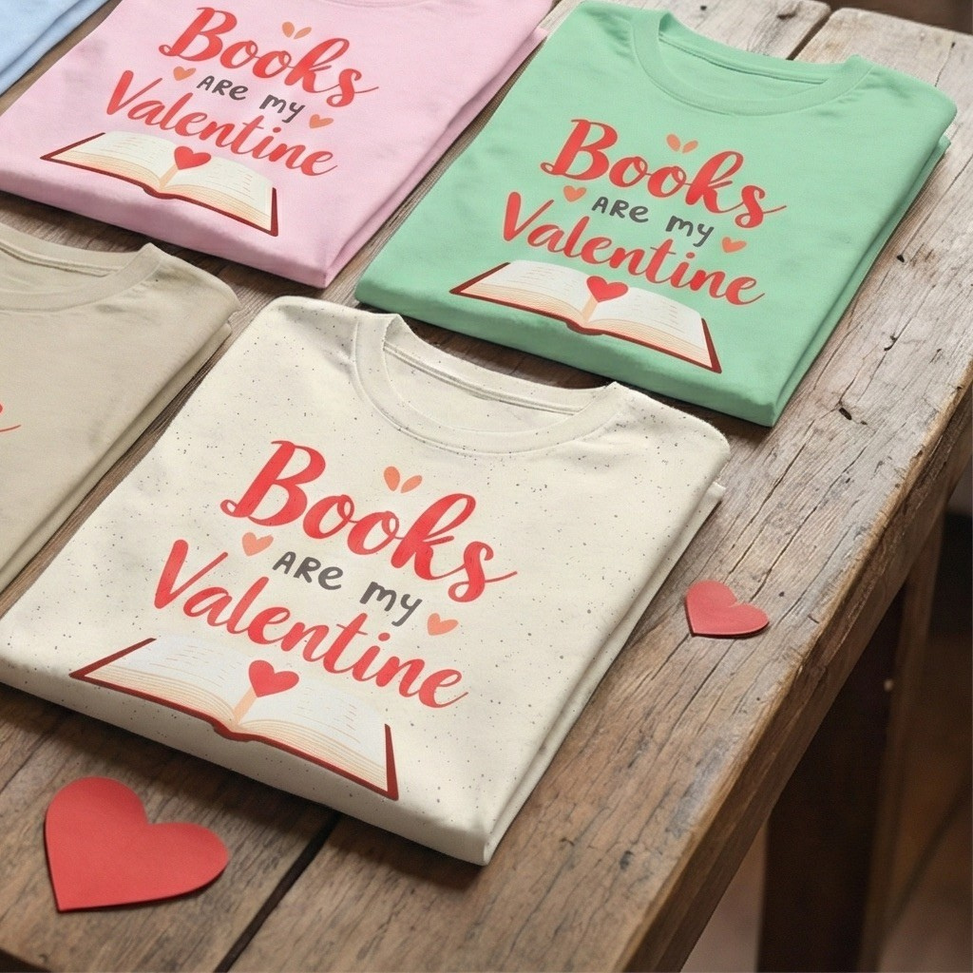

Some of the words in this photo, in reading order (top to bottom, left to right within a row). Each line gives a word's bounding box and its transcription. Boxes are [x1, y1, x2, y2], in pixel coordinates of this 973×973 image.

[158, 7, 379, 107] Books
[259, 93, 305, 123] my
[106, 70, 338, 176] Valentine
[540, 118, 787, 228] Books
[503, 191, 766, 305] Valentine
[665, 215, 715, 247] my
[219, 439, 518, 603] Books
[153, 539, 469, 709] Valentine
[359, 580, 423, 627] my
